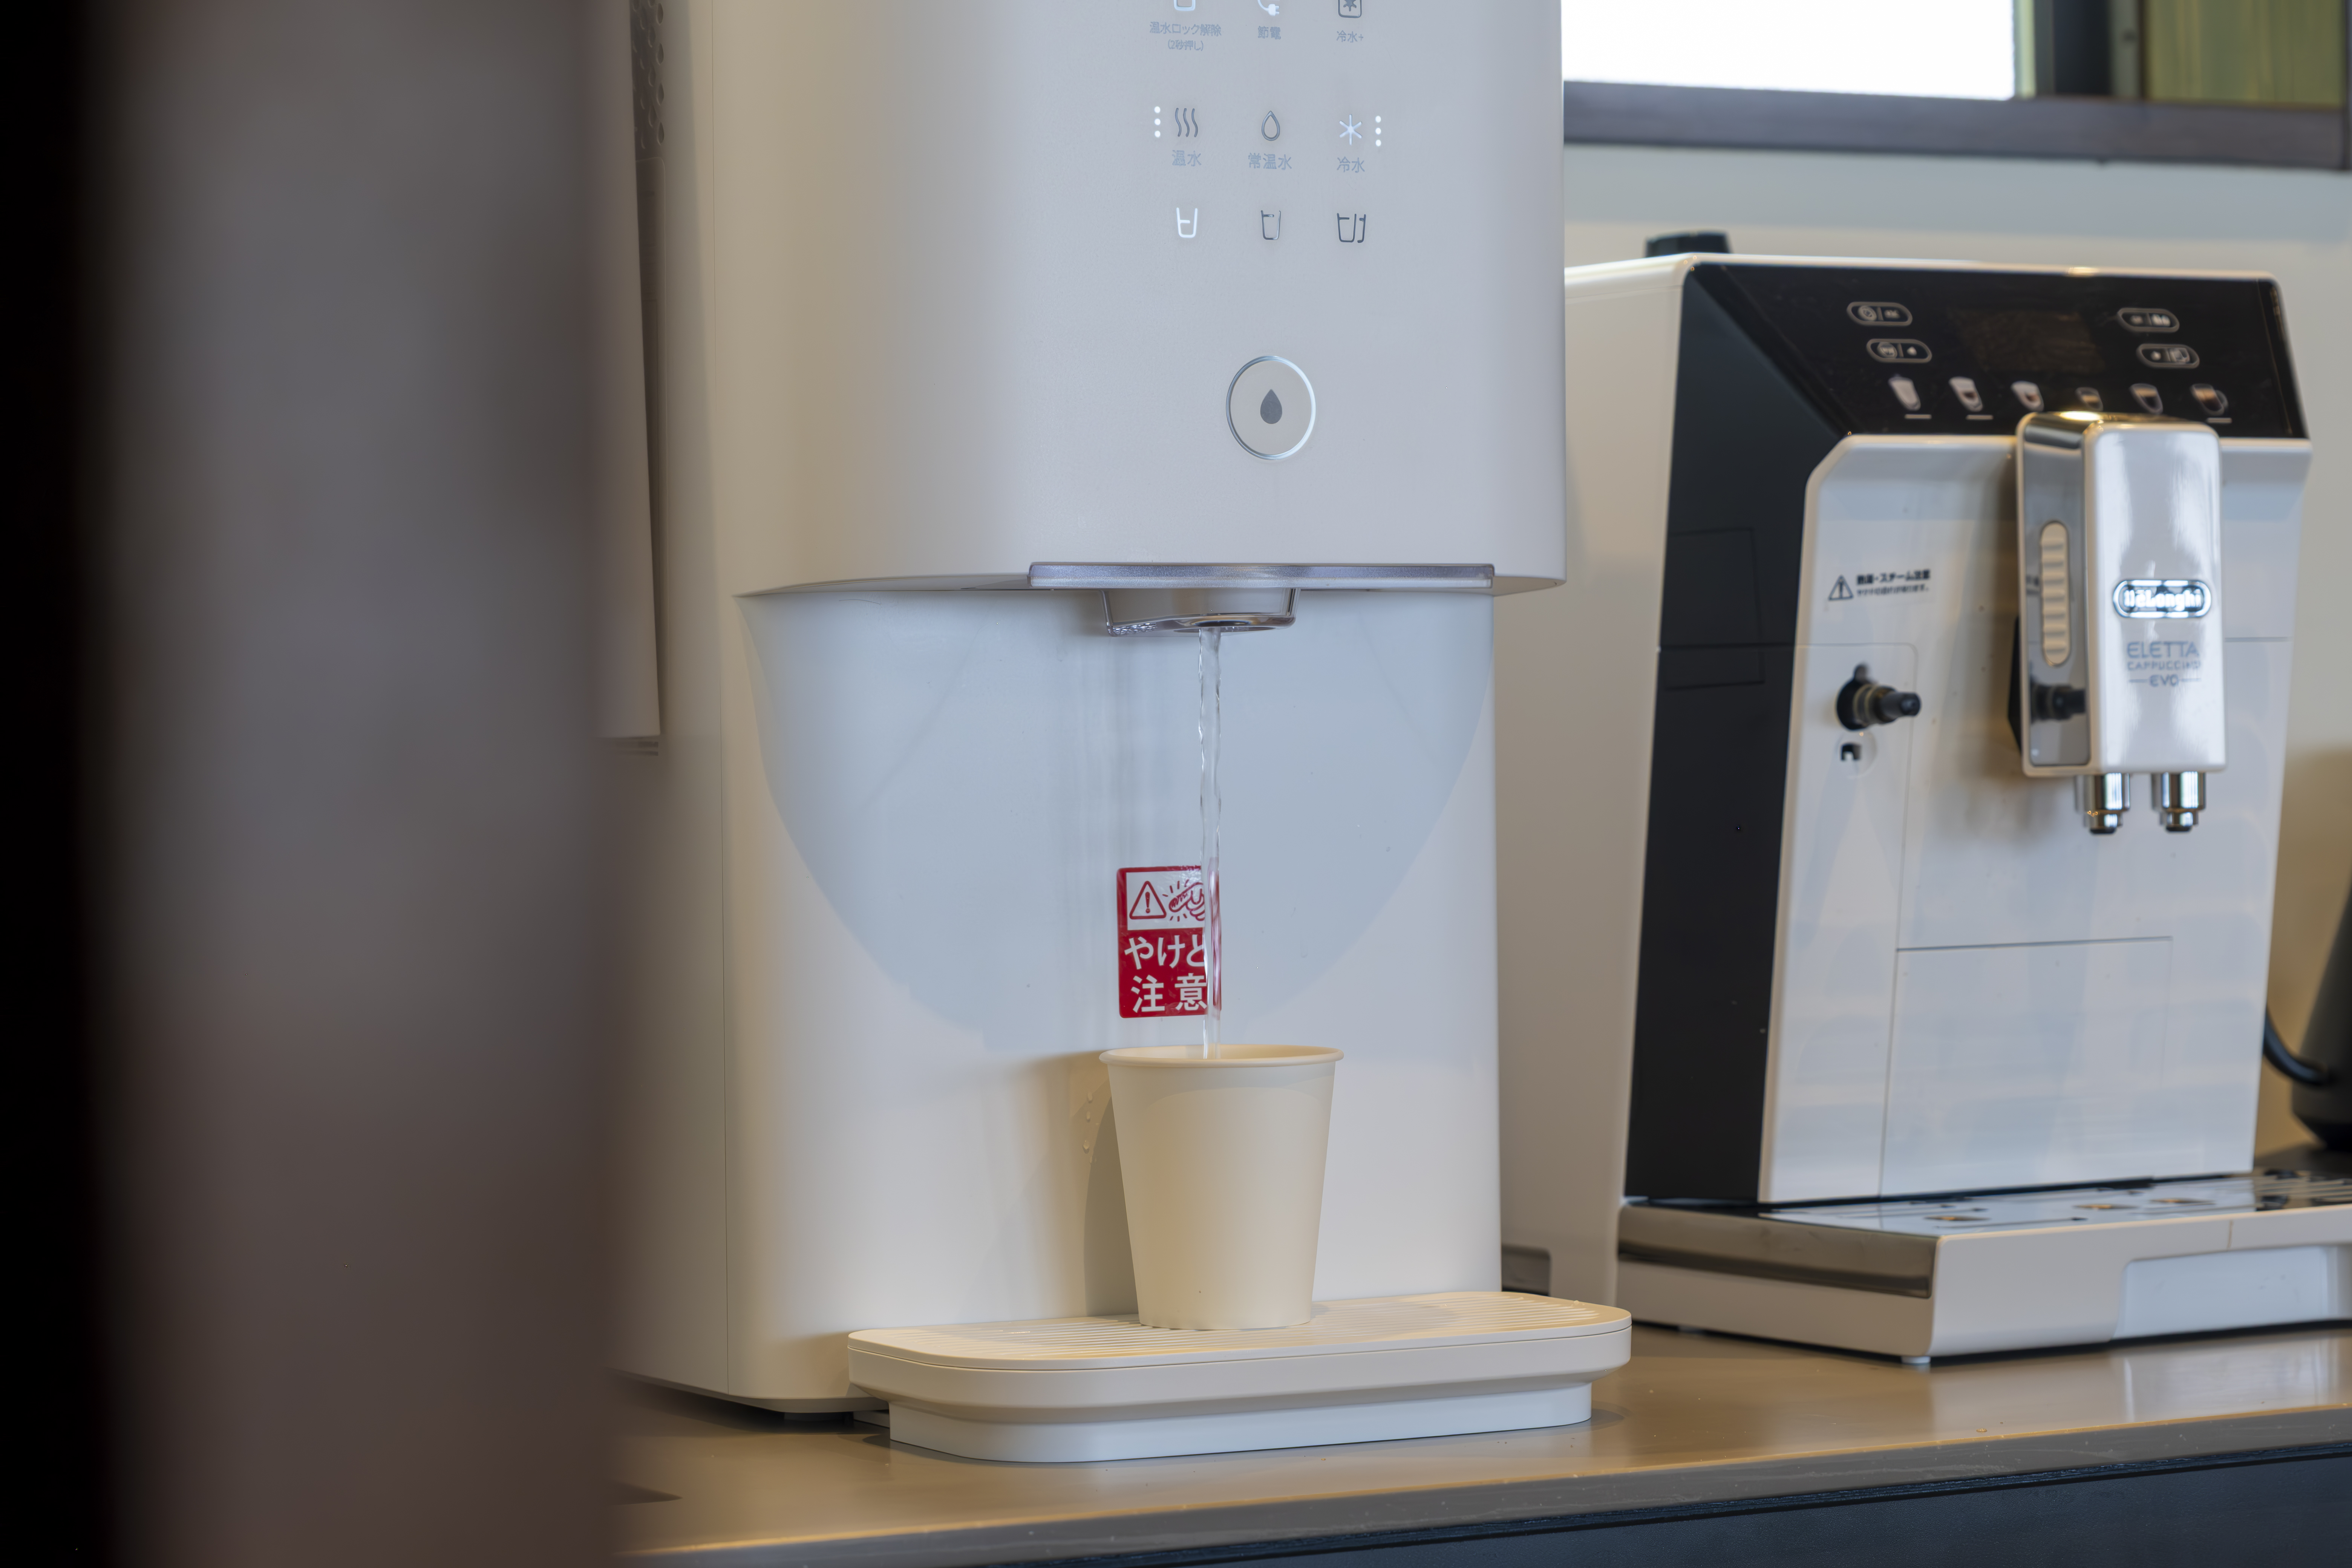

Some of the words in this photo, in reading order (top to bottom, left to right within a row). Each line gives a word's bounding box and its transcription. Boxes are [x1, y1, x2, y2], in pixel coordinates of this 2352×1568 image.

[1149, 21, 1222, 37] 温水ロック解除
[1257, 25, 1282, 40] 節電
[1172, 150, 1202, 167] 温水
[1248, 152, 1292, 170] 常温水
[1337, 156, 1365, 173] 冷水
[2127, 641, 2200, 658] ELETTA
[2149, 674, 2179, 687] EVO
[1130, 972, 1208, 1013] 注意
